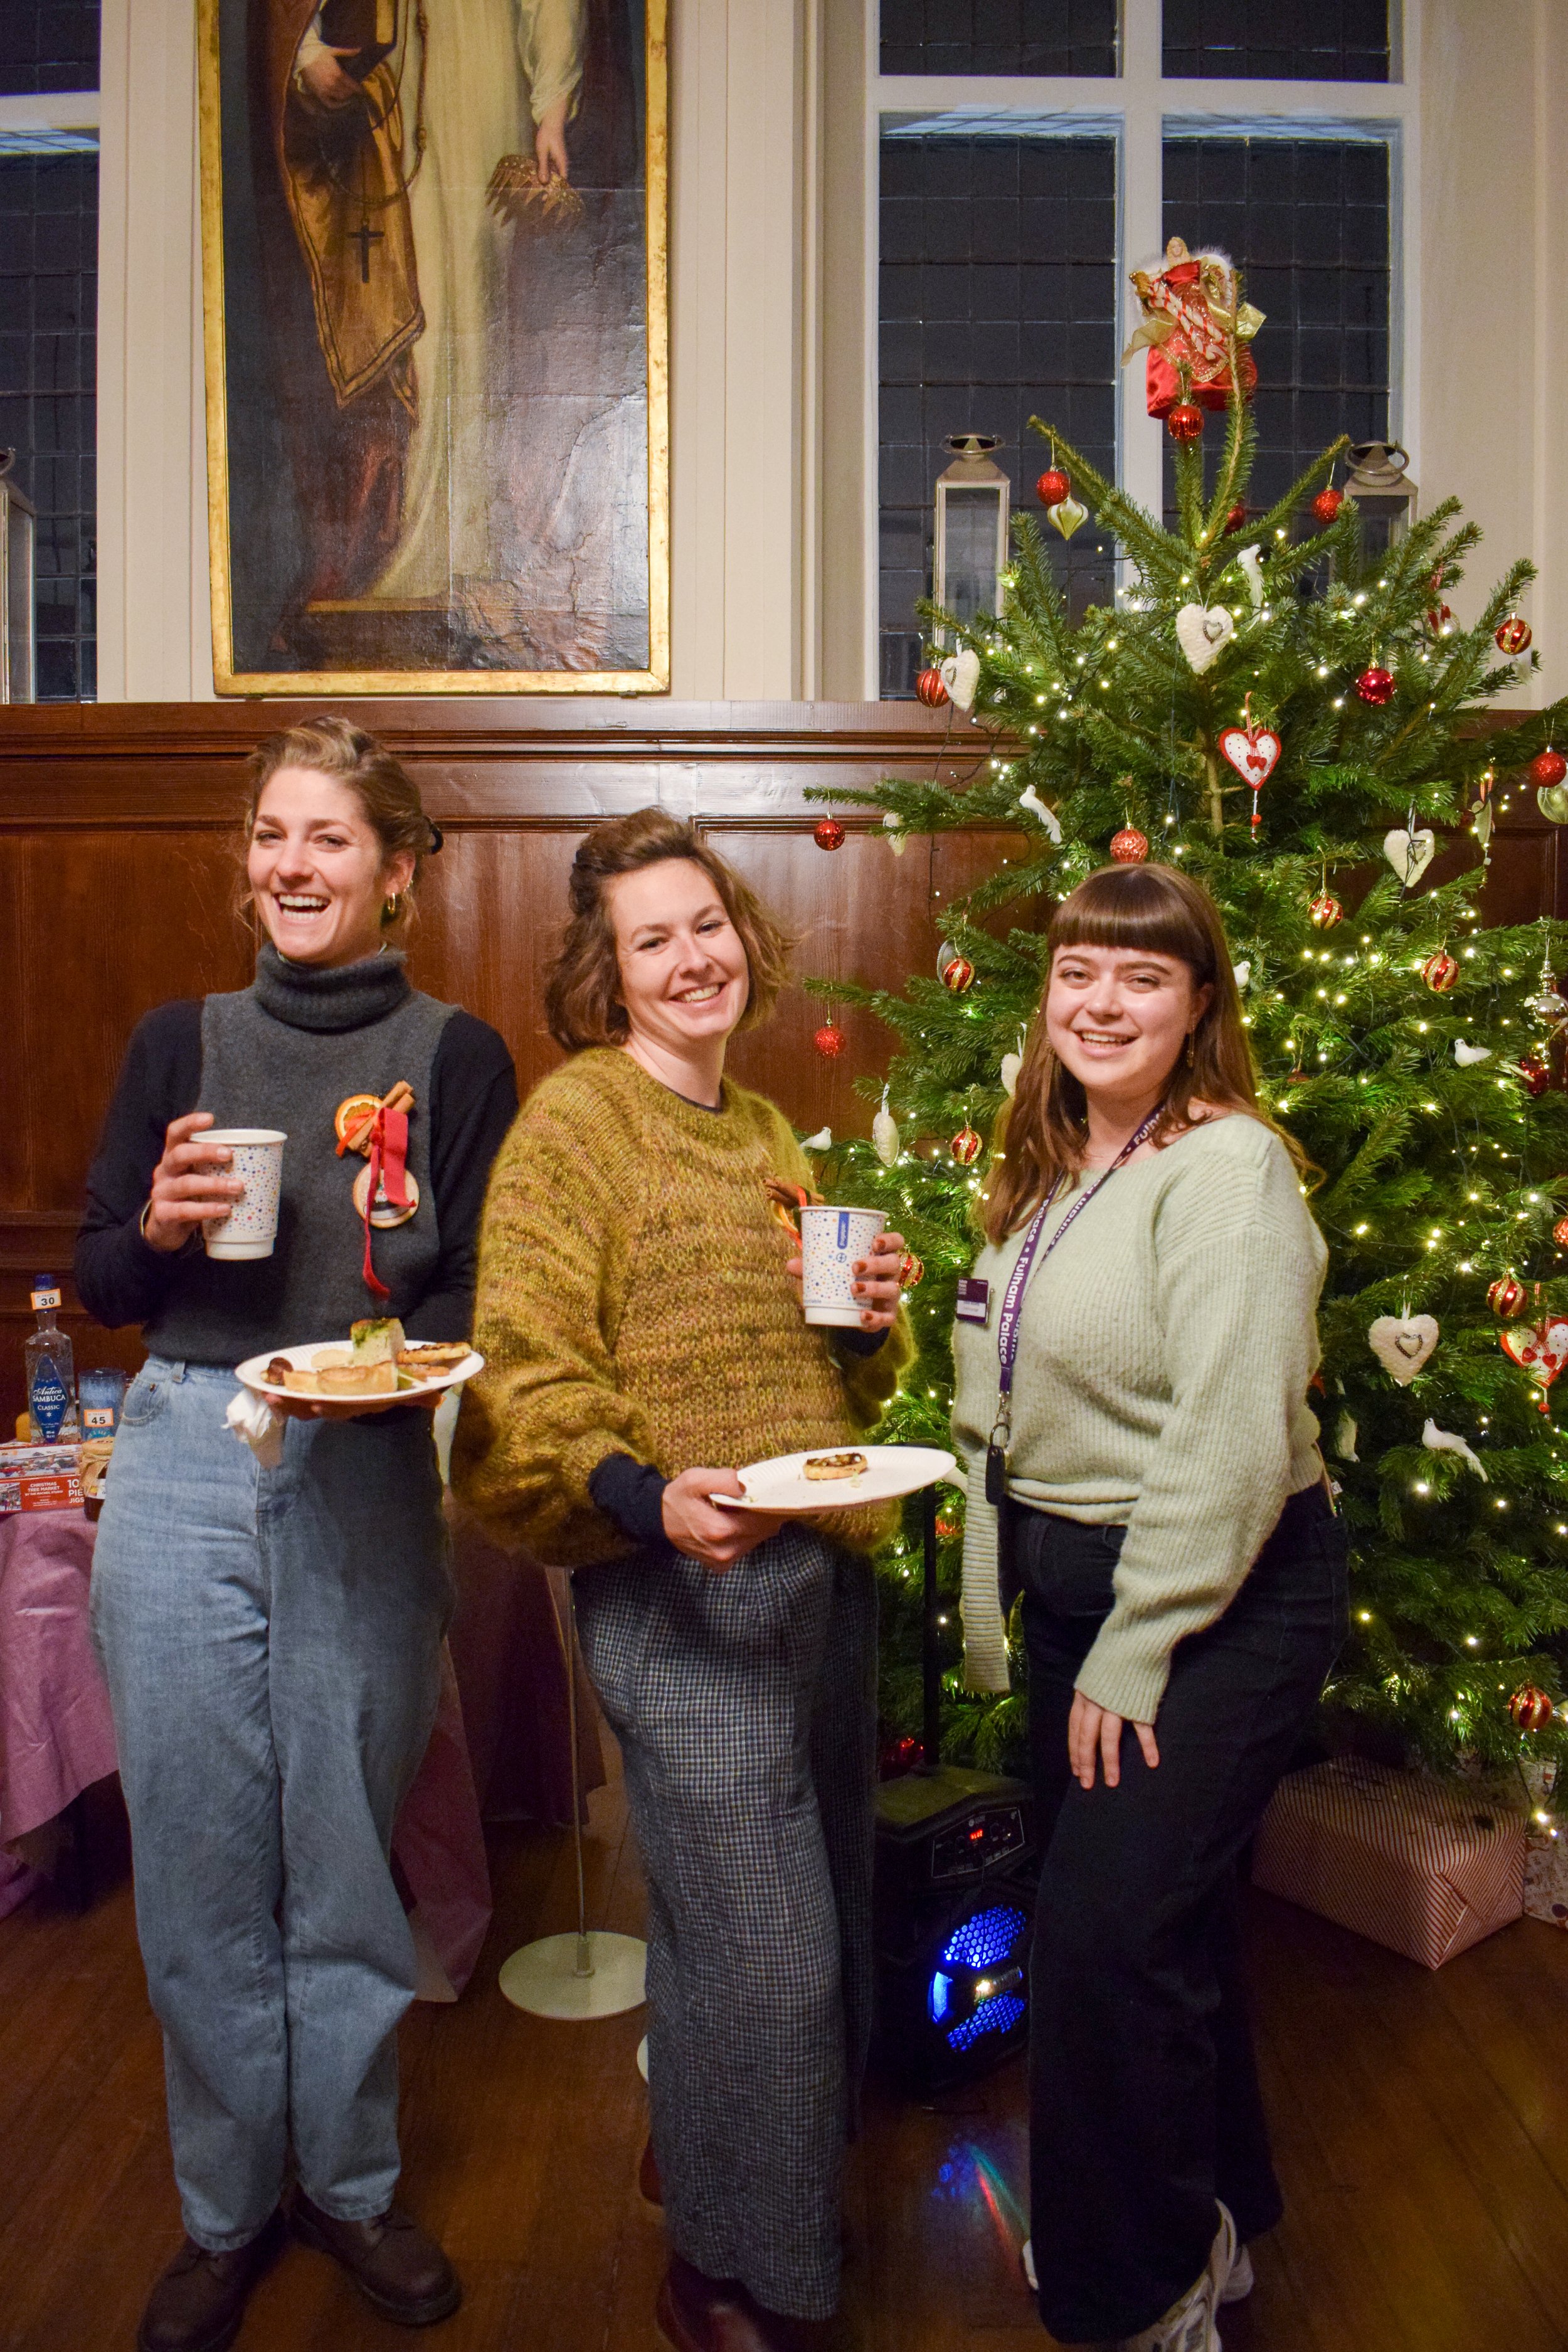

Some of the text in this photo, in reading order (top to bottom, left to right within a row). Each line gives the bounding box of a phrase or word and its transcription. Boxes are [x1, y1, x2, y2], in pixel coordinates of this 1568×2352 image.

[1027, 1199, 1049, 1242] Palace
[1005, 1257, 1028, 1308] Fulham
[41, 1297, 55, 1306] 30
[999, 1312, 1014, 1364] Palace
[33, 1386, 62, 1395] Antica
[33, 1394, 66, 1402] SAMBUCA
[92, 1416, 106, 1424] 45
[68, 1479, 80, 1488] 10
[68, 1489, 83, 1497] PIE
